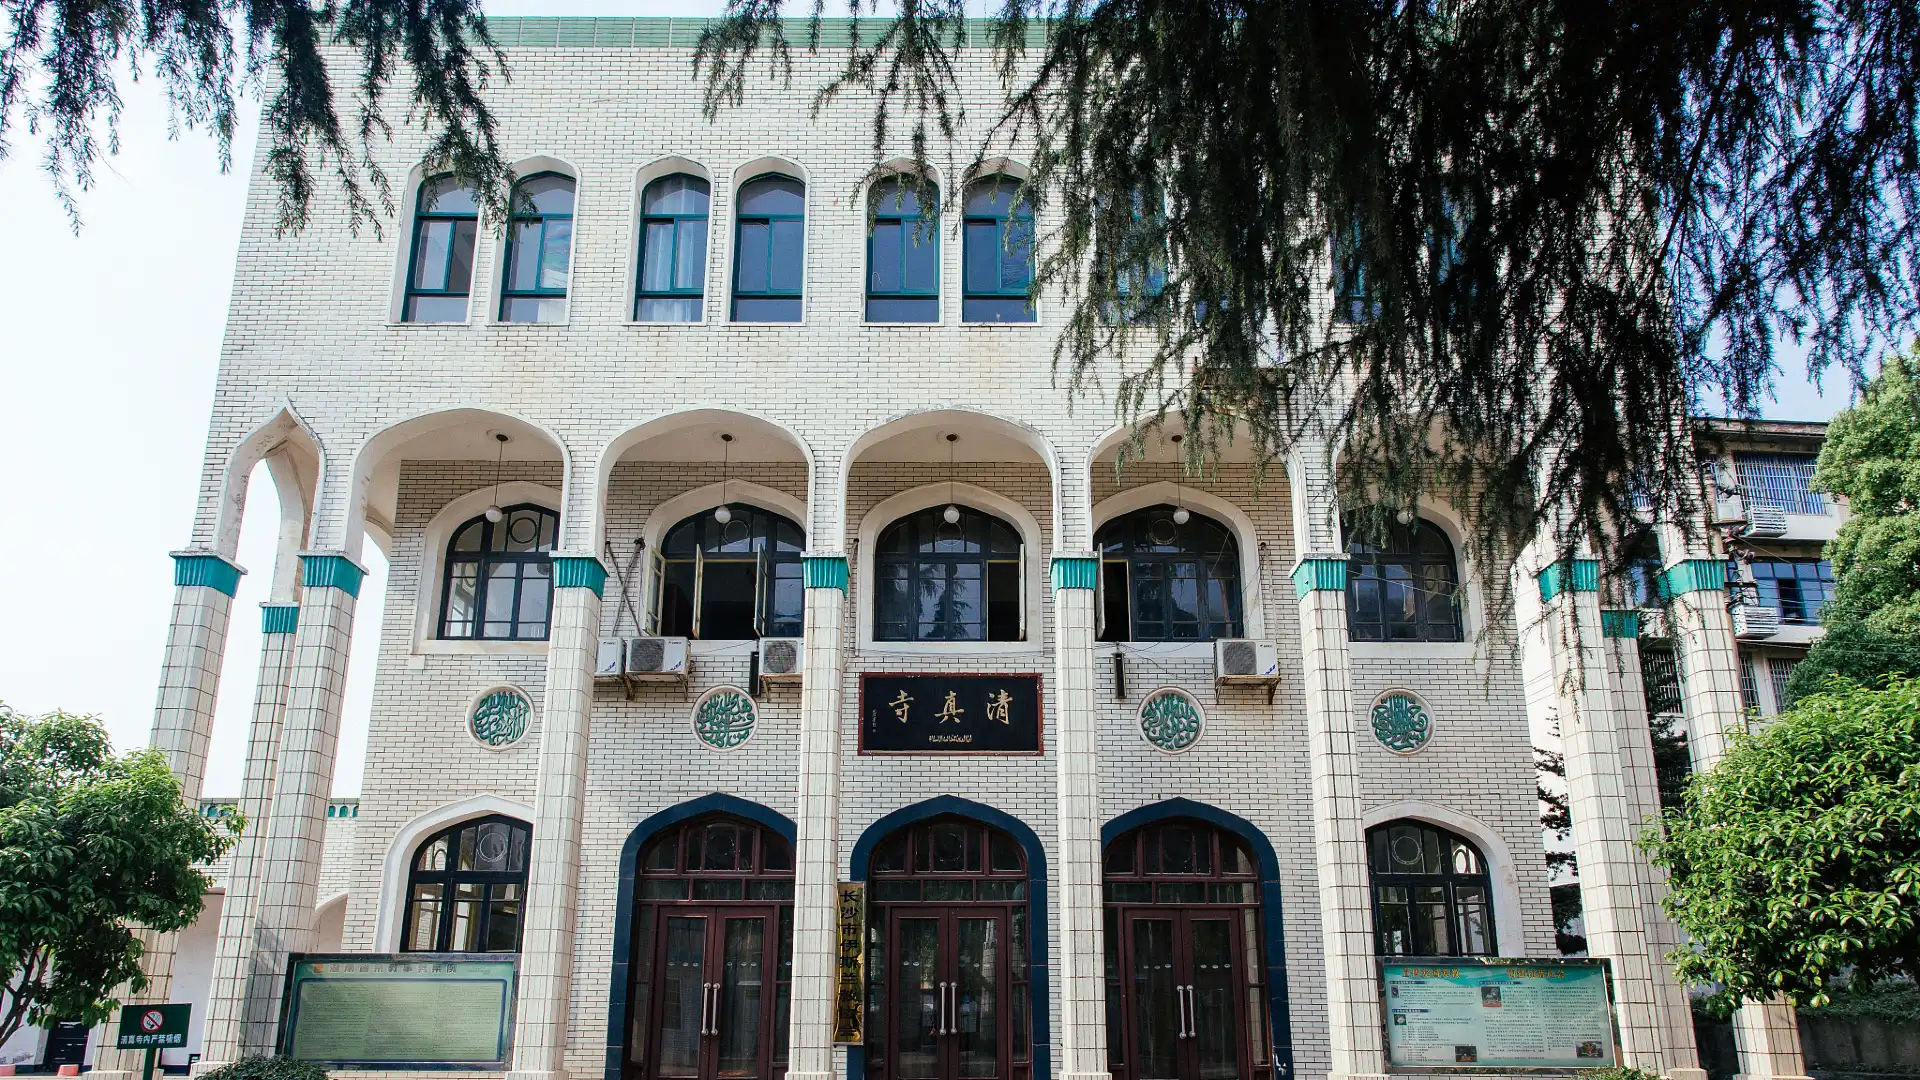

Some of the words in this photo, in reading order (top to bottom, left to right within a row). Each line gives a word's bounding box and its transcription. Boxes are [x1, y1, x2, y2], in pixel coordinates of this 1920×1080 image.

[888, 689, 1013, 725] 清真寺
[120, 1033, 182, 1045] 清真寺内严禁吸烟
